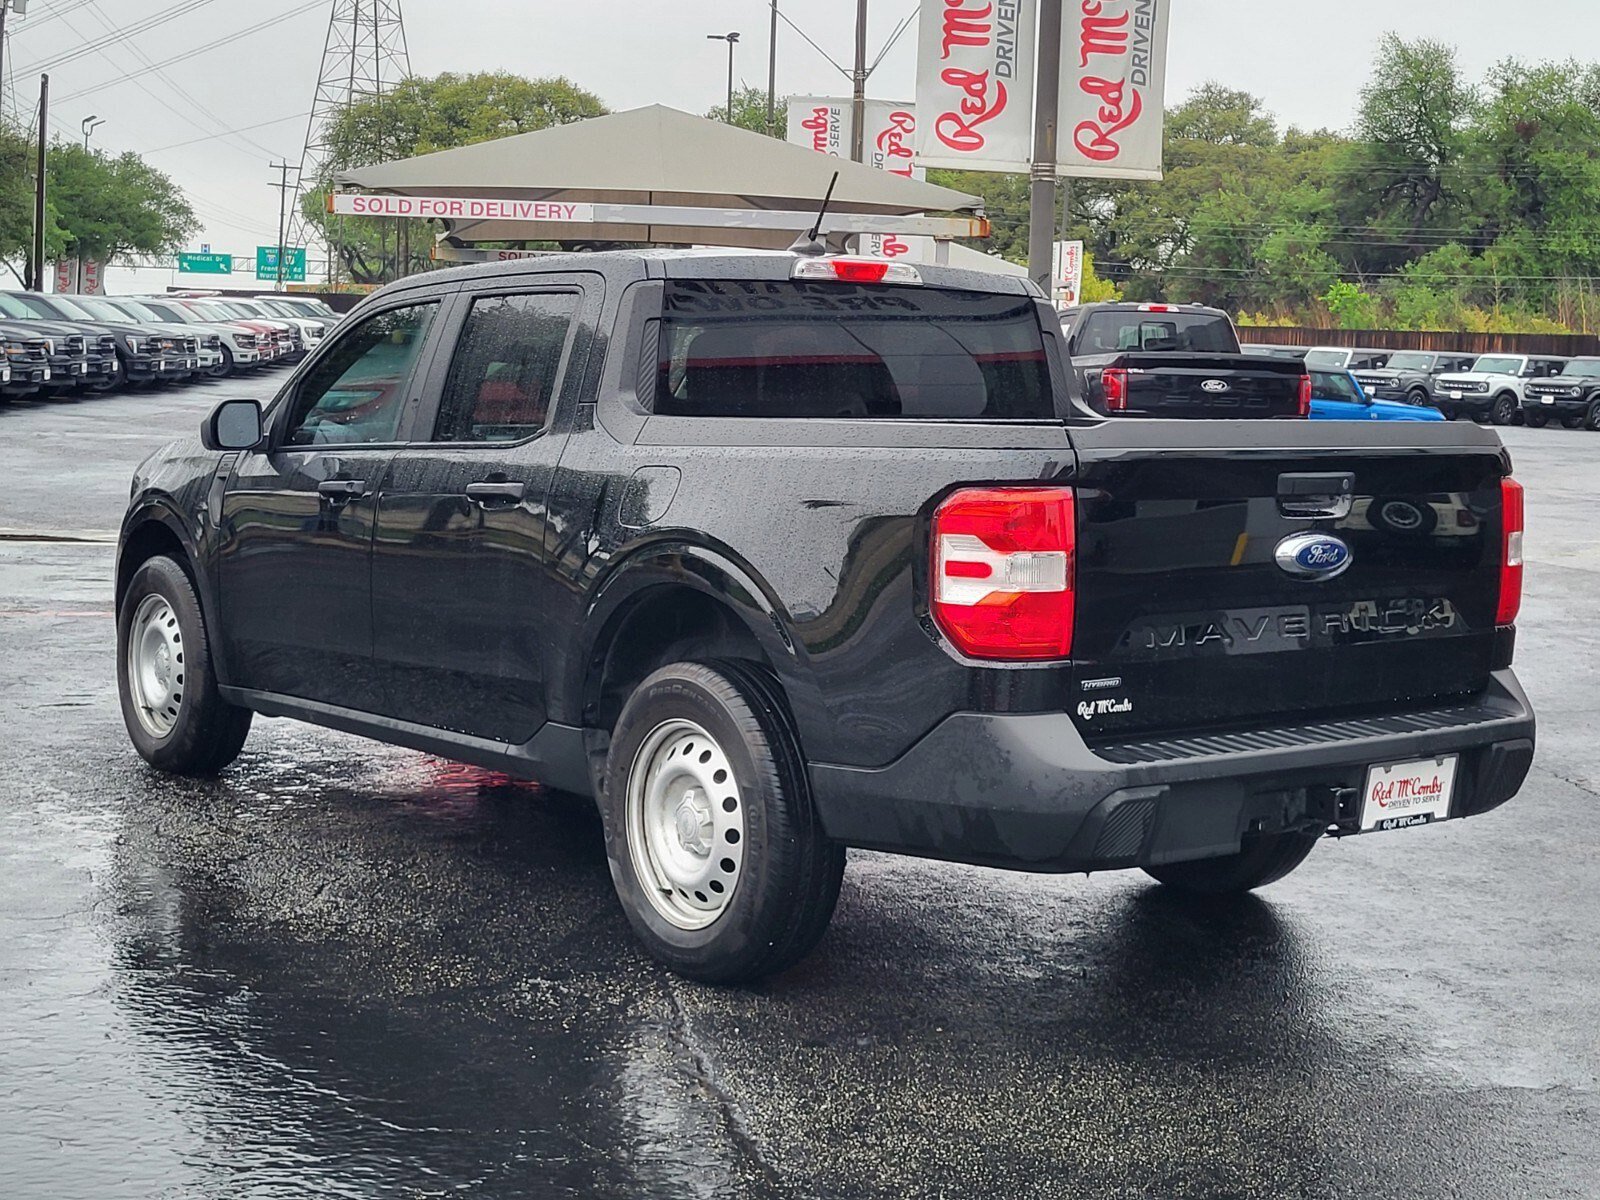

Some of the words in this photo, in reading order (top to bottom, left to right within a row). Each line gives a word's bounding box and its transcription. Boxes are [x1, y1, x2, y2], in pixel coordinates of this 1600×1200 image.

[936, 68, 1007, 151] Red
[1074, 76, 1142, 160] Red
[830, 107, 841, 147] SERVE
[877, 112, 915, 158] Red
[353, 197, 412, 214] SOLD
[420, 199, 463, 216] FOR
[470, 202, 577, 219] DELIVERY
[1307, 544, 1339, 564] Ford
[1146, 598, 1456, 648] MAVERICK
[1083, 679, 1120, 689] HYBRID
[1077, 701, 1095, 720] Red
[1096, 698, 1132, 714] McCombs
[1372, 781, 1395, 807] Red
[1397, 775, 1443, 798] McCombs
[1388, 799, 1410, 808] DRIVEN
[1422, 795, 1440, 803] SERVE
